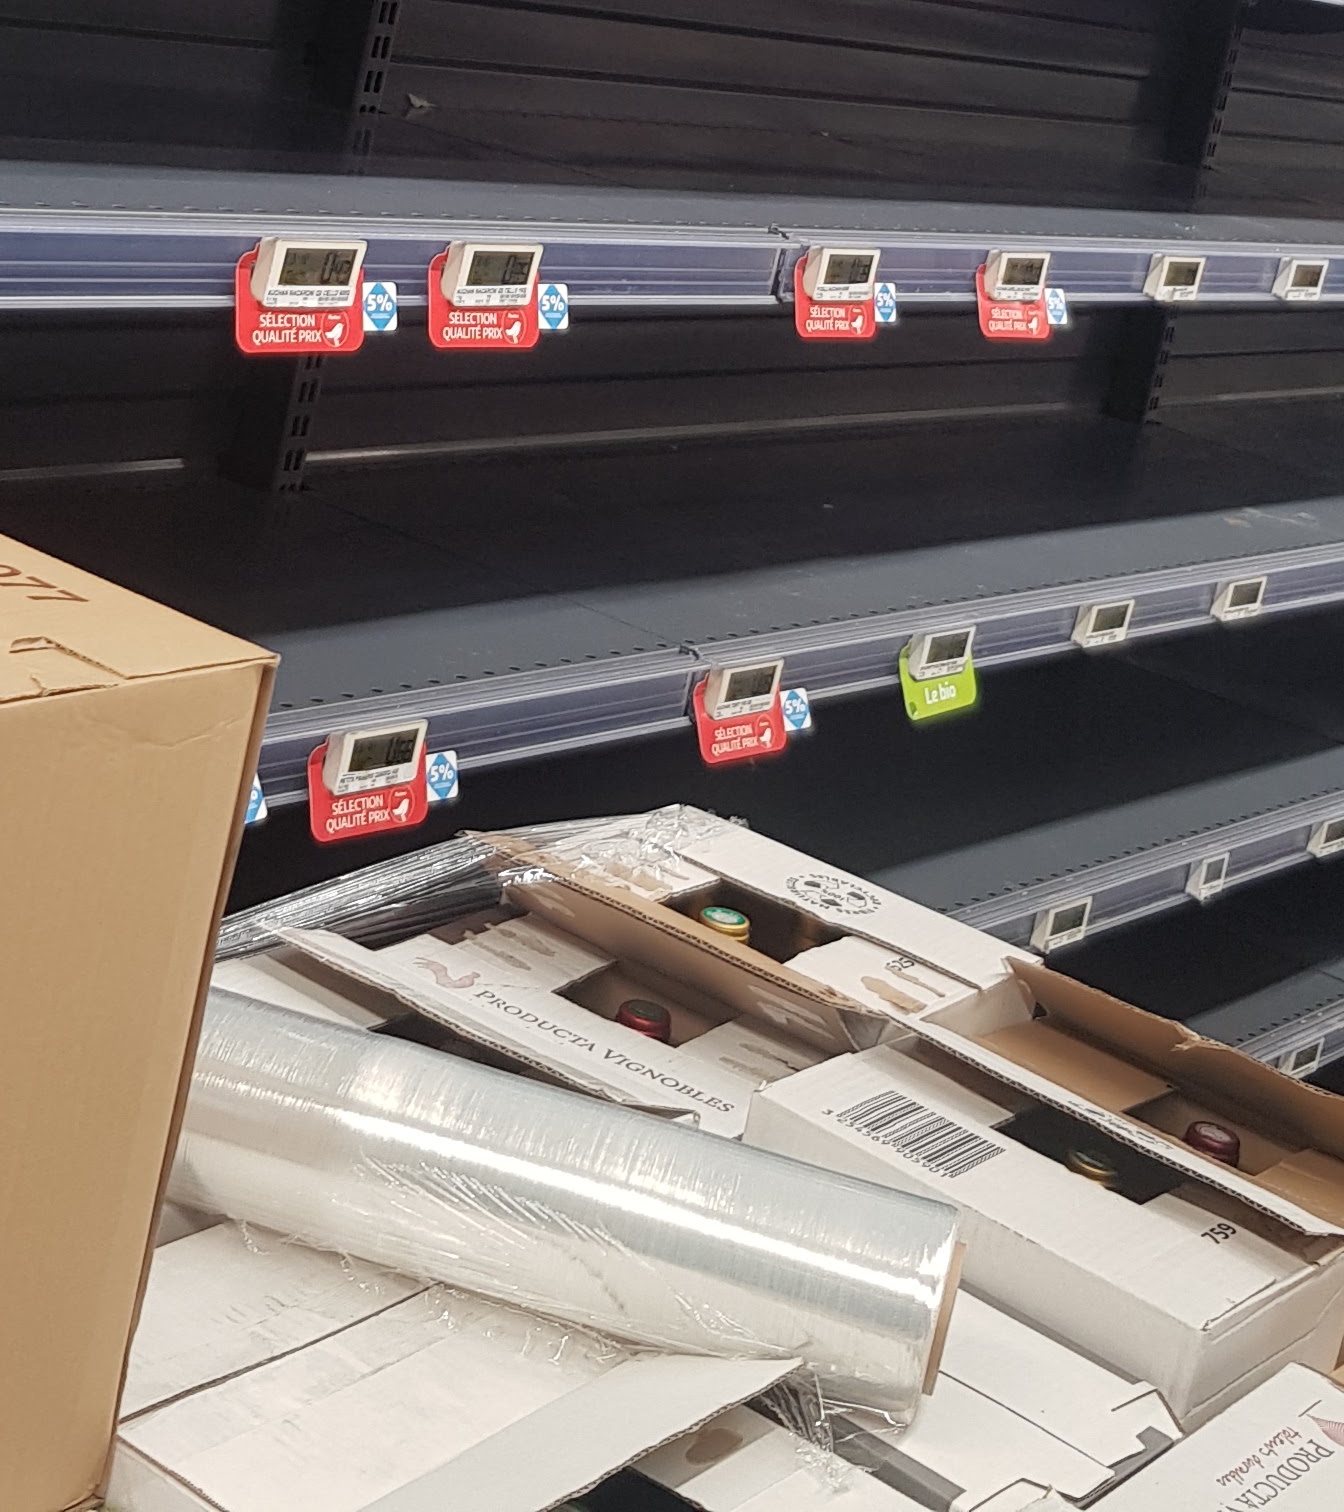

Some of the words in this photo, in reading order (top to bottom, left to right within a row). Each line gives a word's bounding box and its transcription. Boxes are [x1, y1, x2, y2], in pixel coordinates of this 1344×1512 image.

[367, 294, 393, 311] 5%
[542, 294, 564, 312] 5%
[876, 293, 894, 307] 5%
[259, 312, 315, 327] SÉLECTION
[449, 310, 497, 325] SÉLECTION
[810, 305, 846, 318] SÉLECTION
[442, 324, 480, 341] QUALITÉ
[482, 326, 503, 339] PRIX
[806, 317, 834, 332] QUALITÉ
[835, 319, 849, 331] PRIX
[252, 328, 297, 345] QUALITÉ
[299, 330, 322, 343] PRIX
[925, 687, 938, 705] Le
[938, 681, 956, 699] bio
[785, 698, 806, 713] 5%
[714, 723, 753, 740] SÉLECTION
[712, 739, 742, 756] QUALITÉ
[429, 767, 454, 783] 5%
[331, 794, 384, 816] SÉLECTION
[325, 812, 367, 834] QUALITÉ
[368, 808, 390, 824] PRIX
[473, 989, 597, 1052] PRODUCTA
[602, 1047, 736, 1113] VIGNOBLES
[1201, 1223, 1236, 1244] 759
[1235, 1439, 1335, 1510] PRODUCTA
